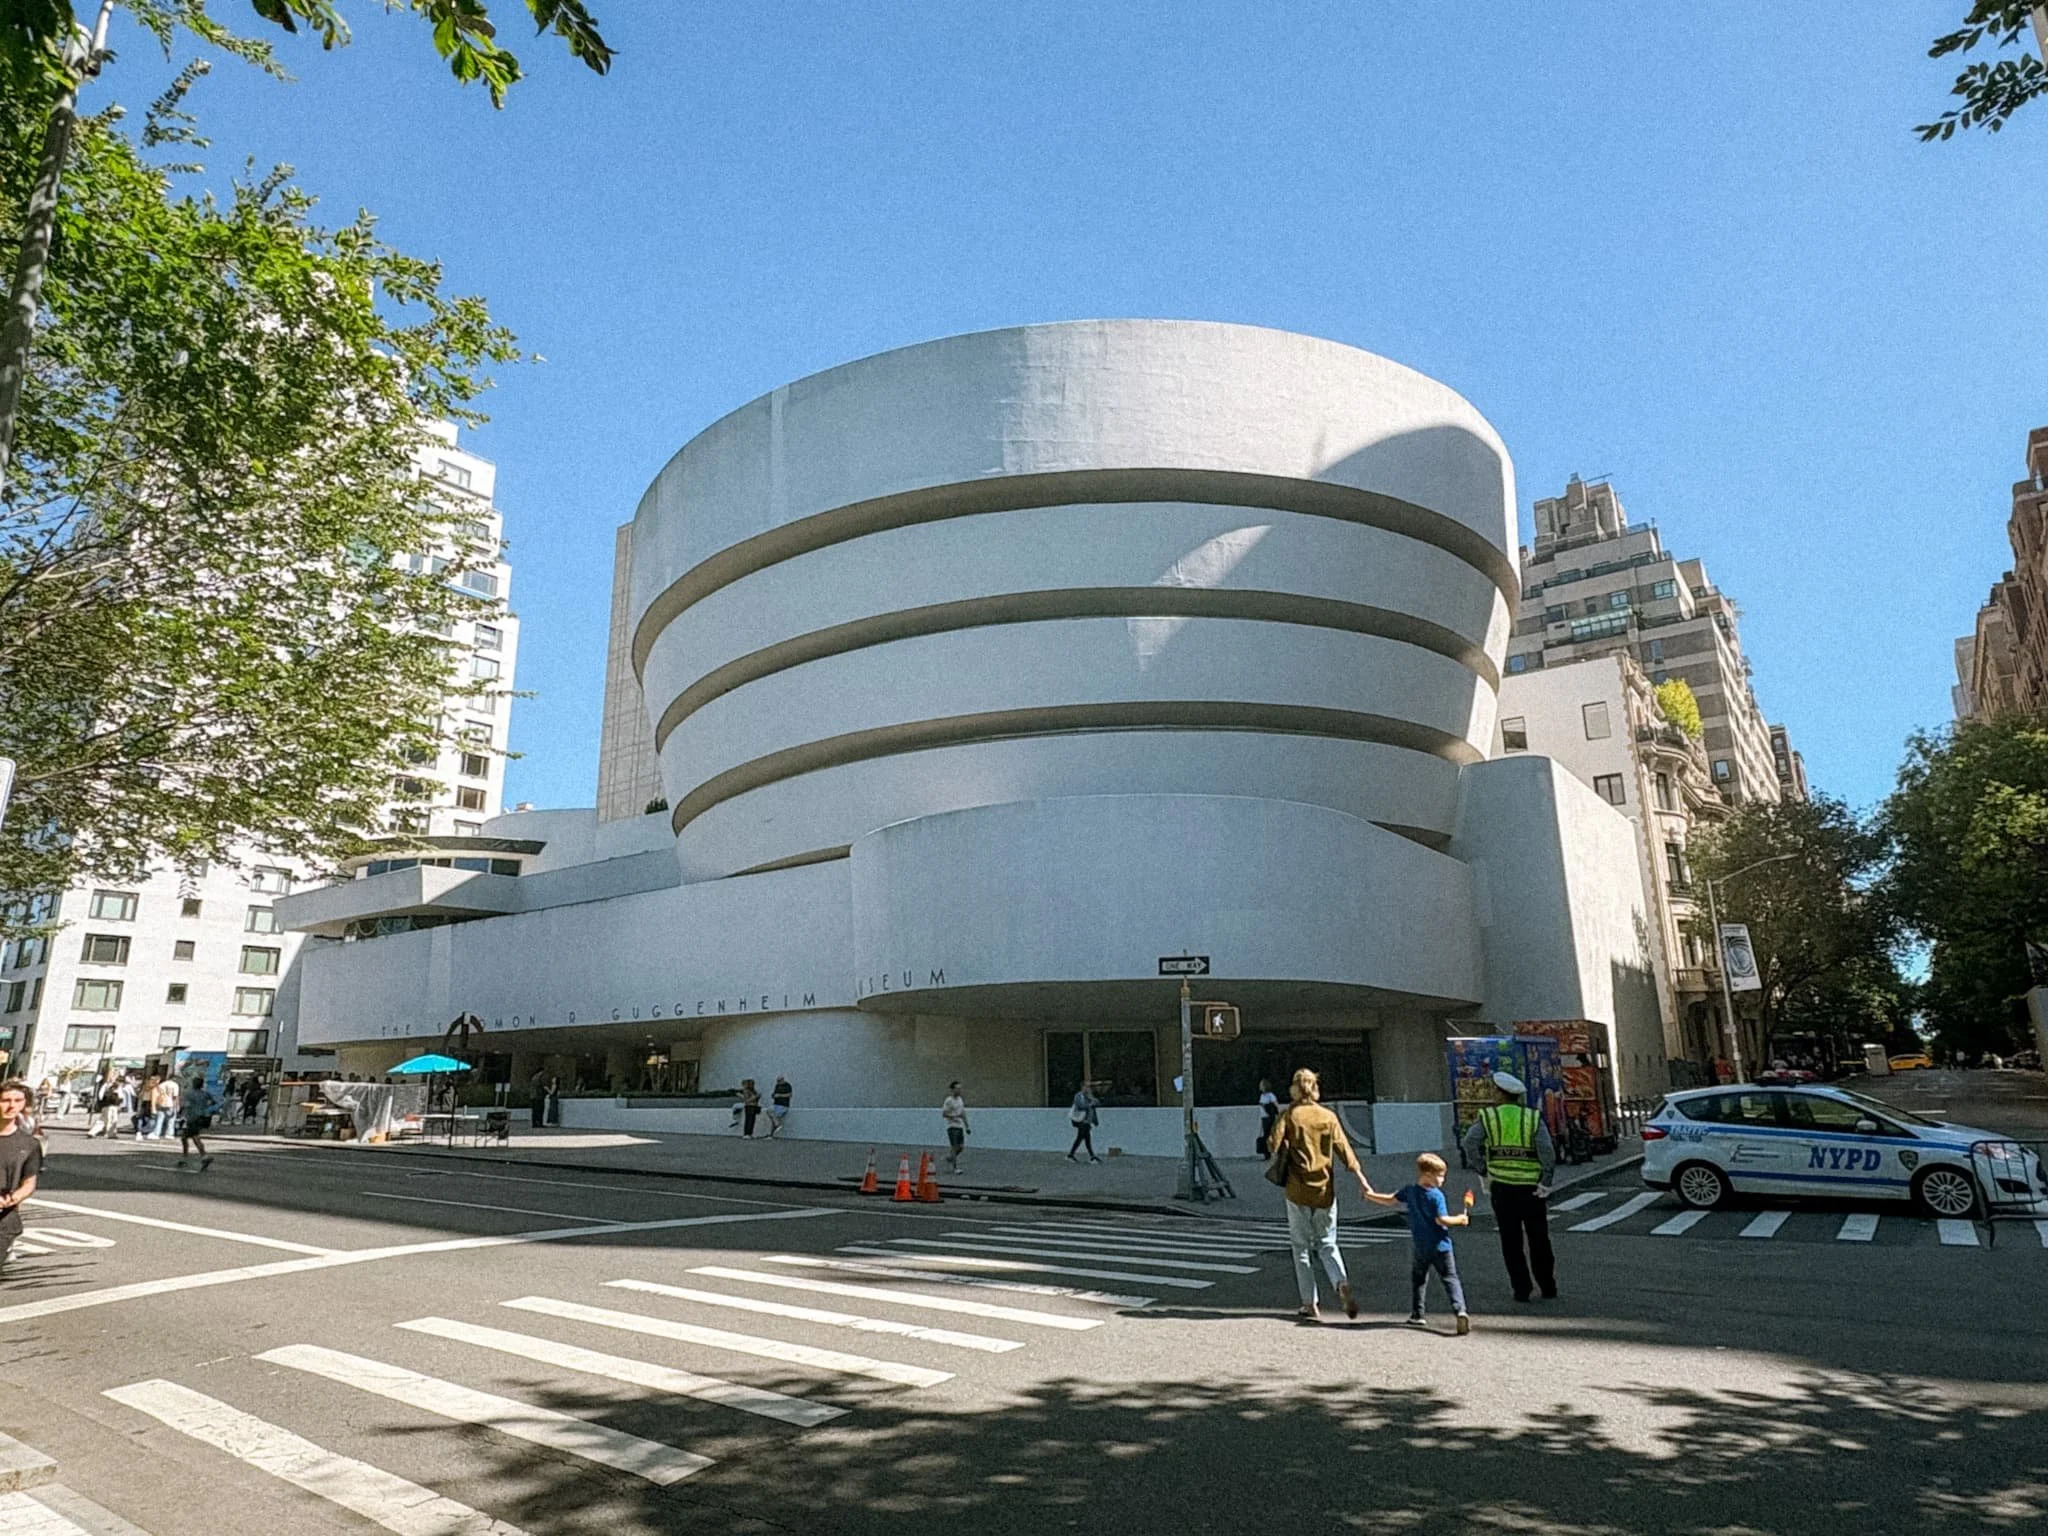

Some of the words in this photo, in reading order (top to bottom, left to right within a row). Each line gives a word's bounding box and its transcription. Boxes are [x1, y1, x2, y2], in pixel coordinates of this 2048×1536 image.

[1186, 962, 1201, 970] WAY
[437, 1015, 536, 1034] SMON
[610, 992, 817, 1021] GUGGENHEIM
[1808, 1145, 1881, 1171] NYPD
